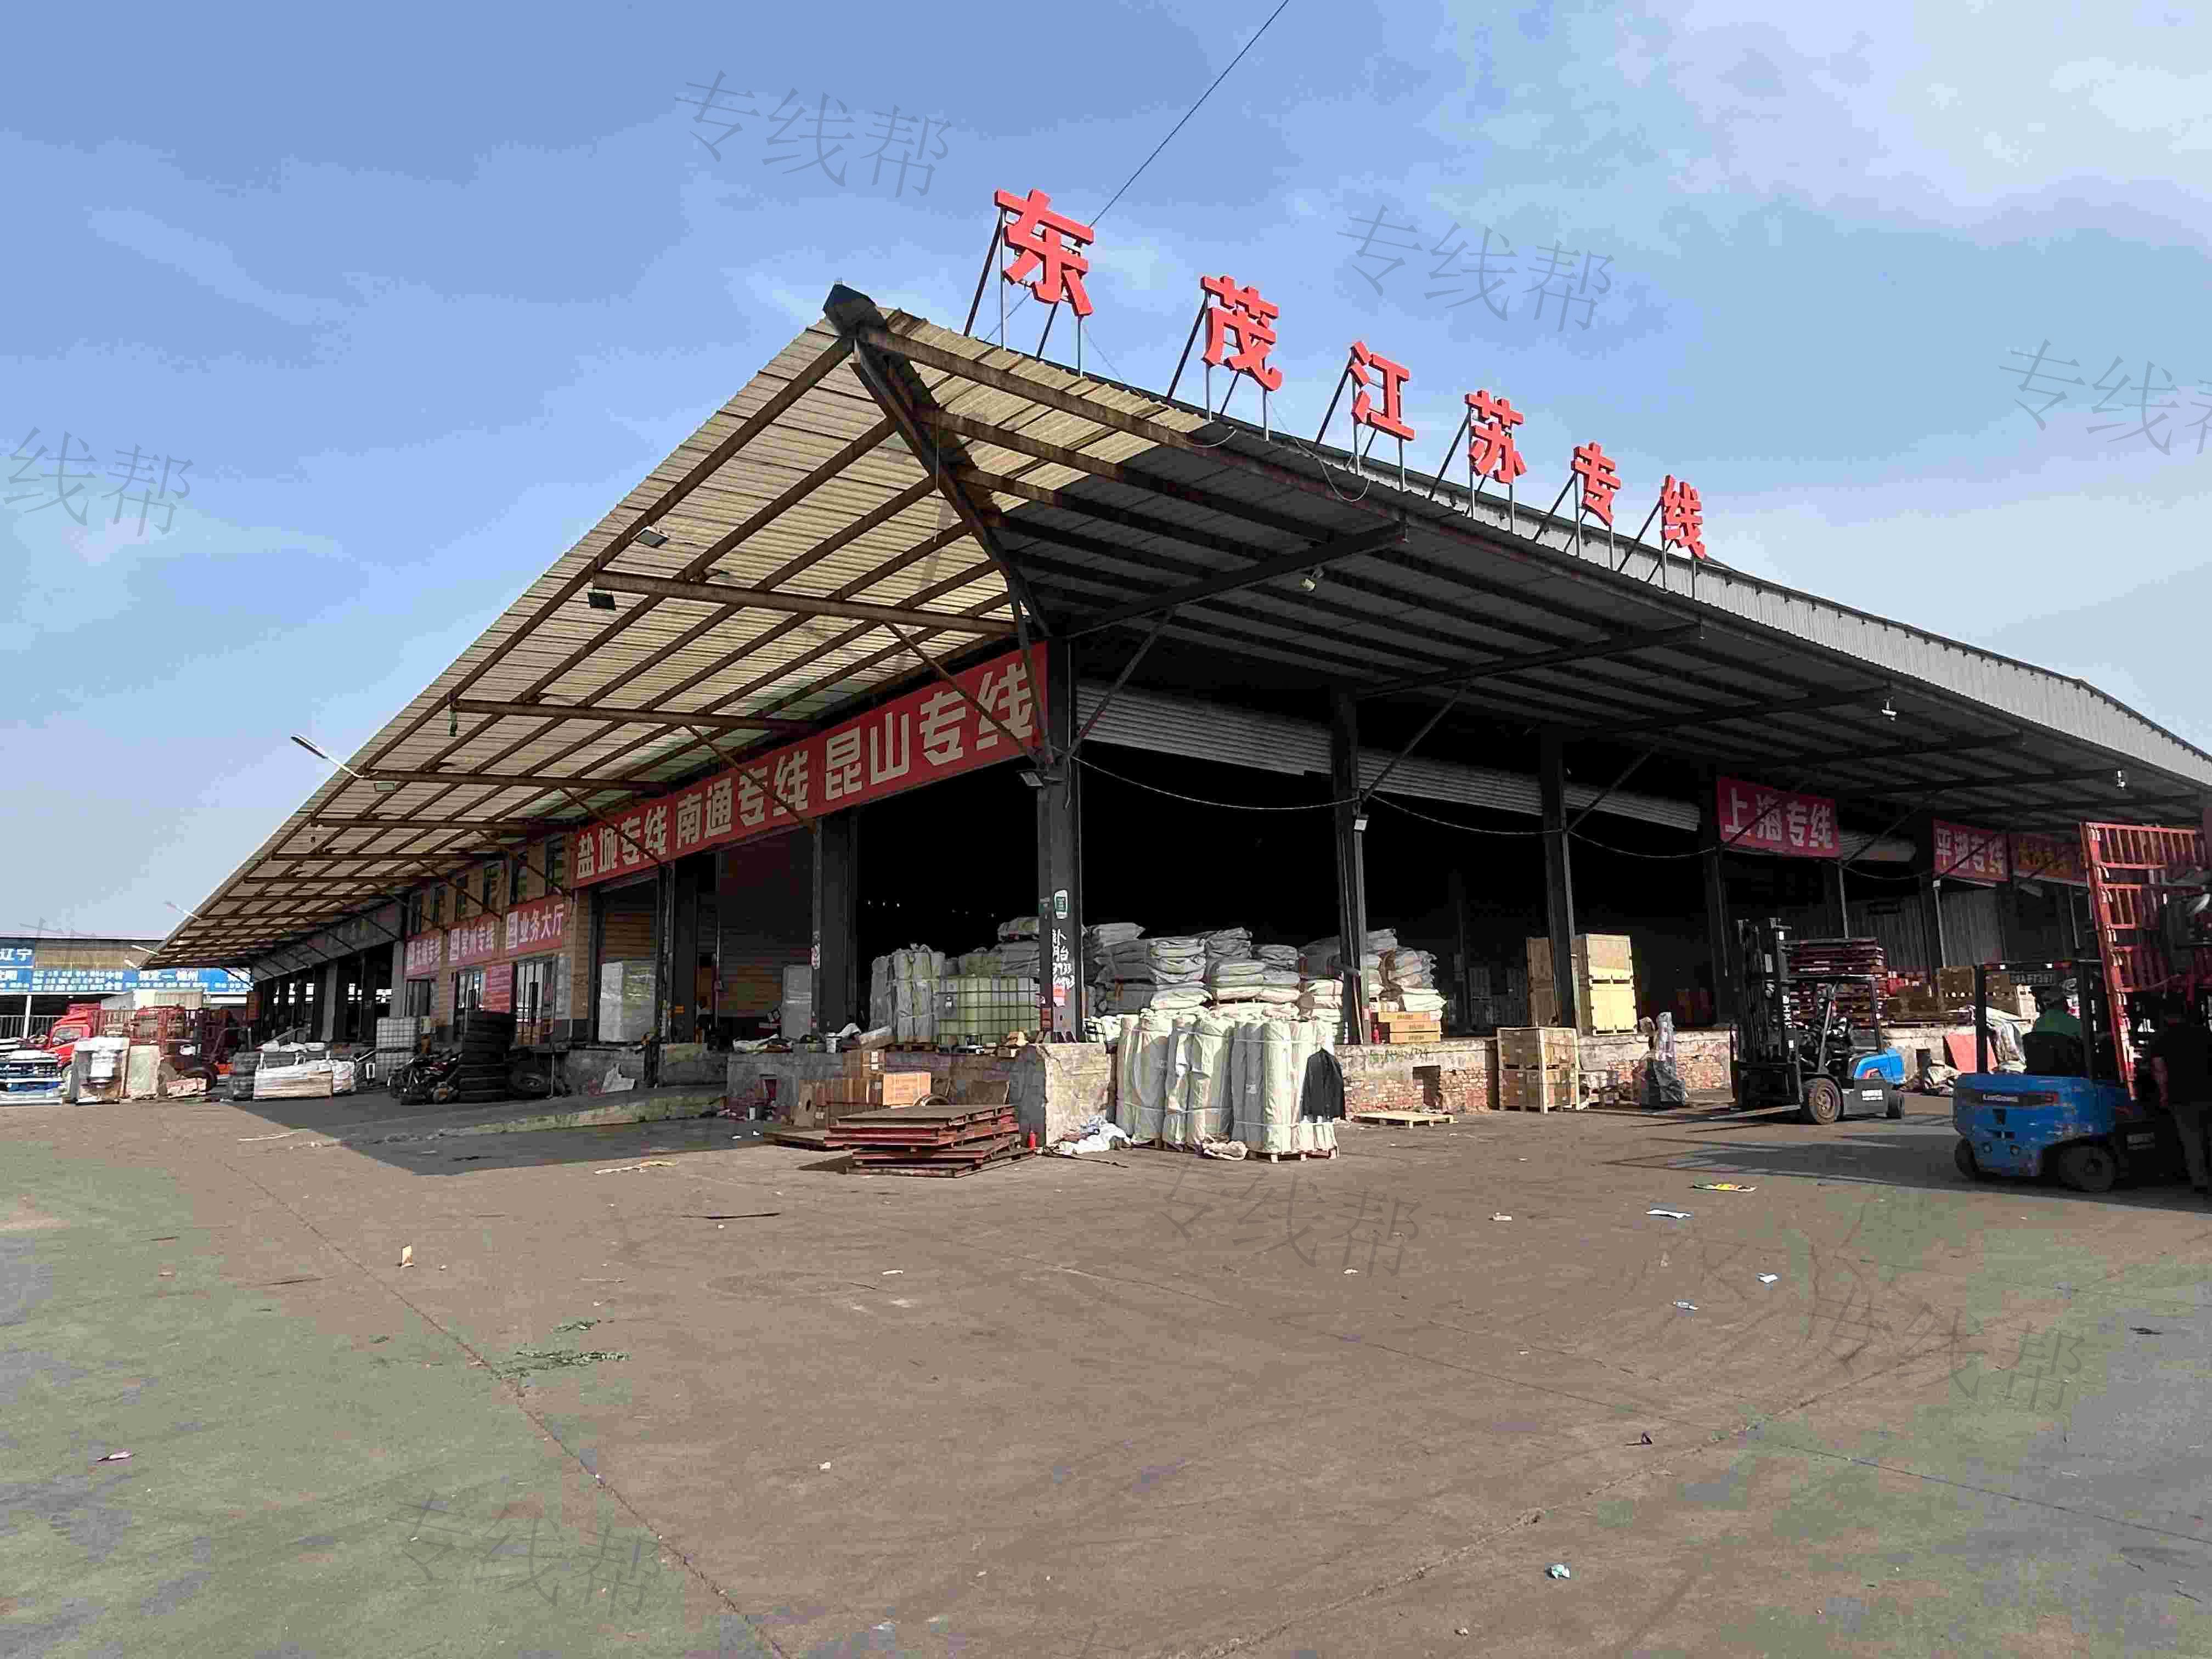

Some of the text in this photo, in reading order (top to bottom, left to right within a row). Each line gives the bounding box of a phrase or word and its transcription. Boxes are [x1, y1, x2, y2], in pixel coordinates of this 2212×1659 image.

[994, 188, 1705, 559] 东茂江苏专线
[825, 661, 1034, 801] 昆山专线
[577, 805, 668, 879] 盐城专线
[676, 749, 809, 849] 南通专线
[1725, 788, 1834, 849] 上海专线
[519, 904, 564, 943] 业务大厅
